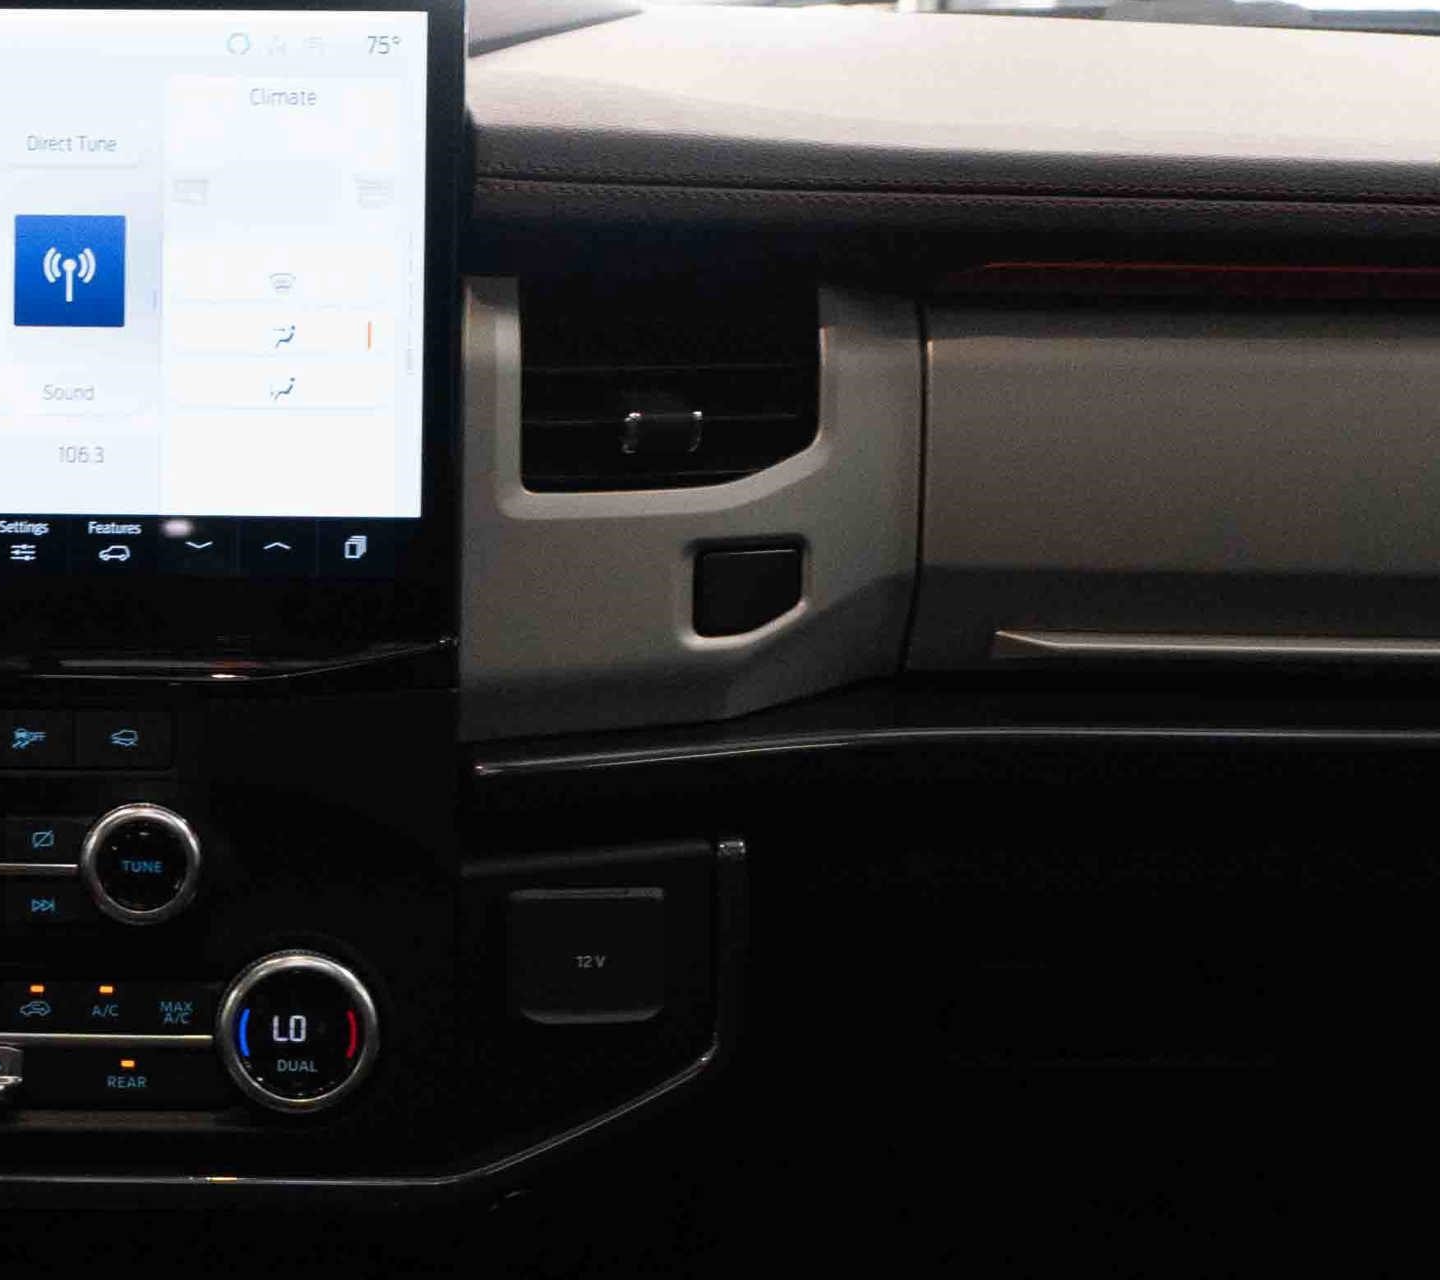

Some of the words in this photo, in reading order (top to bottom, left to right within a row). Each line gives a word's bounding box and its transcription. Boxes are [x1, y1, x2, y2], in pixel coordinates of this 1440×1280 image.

[249, 88, 318, 107] Climate
[26, 135, 73, 152] Direct
[77, 136, 118, 153] Tune
[42, 384, 95, 401] Sound
[57, 445, 106, 464] 106.3
[88, 521, 142, 535] Features
[122, 860, 162, 874] TUNE
[91, 1003, 119, 1018] A/C
[160, 1001, 193, 1013] MAX
[272, 1014, 307, 1042] LO
[276, 1059, 319, 1072] DUAL
[107, 1075, 147, 1089] REAR
